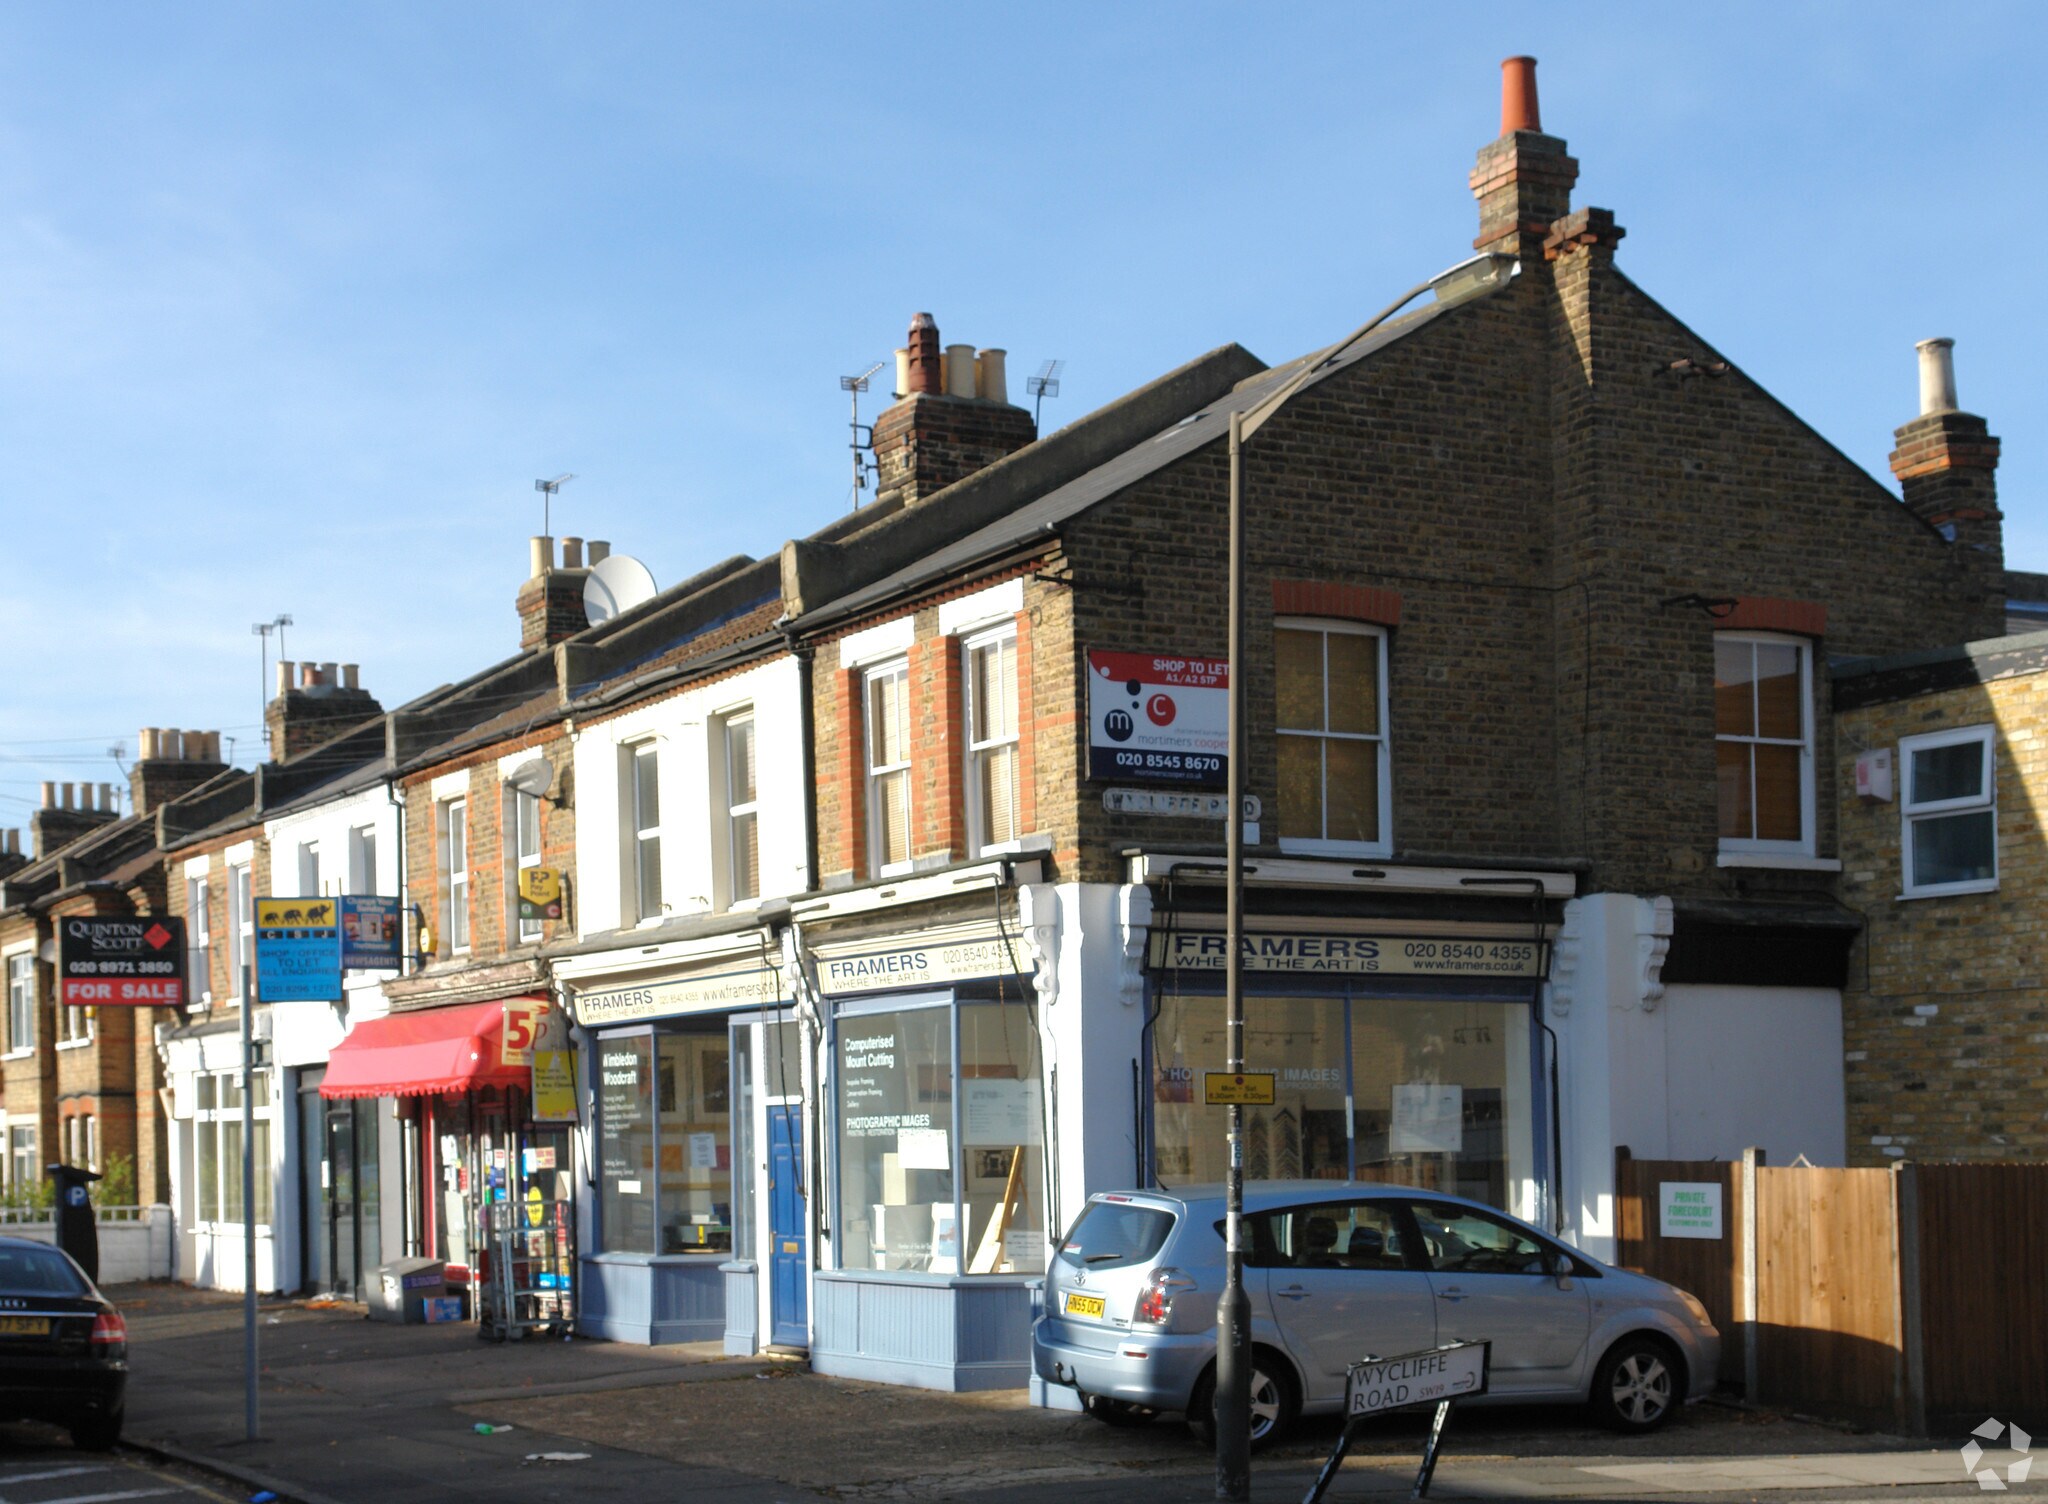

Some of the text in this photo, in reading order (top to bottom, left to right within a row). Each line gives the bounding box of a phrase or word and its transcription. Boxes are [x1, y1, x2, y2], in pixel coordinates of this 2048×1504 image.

[1153, 659, 1229, 676] SHOP TO LET
[1166, 673, 1217, 685] A1/A2 STP
[1137, 734, 1229, 751] mortimers cooper
[1116, 752, 1220, 771] 020 8545 8670
[1111, 793, 1200, 810] WLFFE
[68, 920, 144, 939] QUINTON
[266, 930, 276, 939] C
[320, 930, 328, 939] J
[91, 936, 143, 950] SCOTT
[260, 949, 289, 957] SHOP
[298, 949, 336, 957] OFFICE
[943, 942, 1017, 965] 020 8540 4355
[1404, 943, 1532, 960] 020 8540 4355
[69, 961, 174, 973] 020 8971 3850
[278, 957, 320, 967] TO LET
[344, 956, 398, 966] NEWSAGENTS
[830, 953, 928, 979] FRAMERS
[1175, 955, 1380, 971] WHEE THE ART IS
[1413, 959, 1524, 972] www.framers.co.uk
[261, 967, 337, 976] ALL ENQUIRIES
[833, 971, 930, 989] WHERE THE ART IS
[67, 983, 178, 999] FOR SALE
[265, 985, 282, 993] 020
[286, 984, 309, 993] 8296
[584, 990, 653, 1012] FRAMERS
[587, 1005, 655, 1021] WHERE THE ART IS
[844, 1034, 894, 1053] Computerised
[602, 1052, 638, 1068] Wimbledon
[845, 1052, 894, 1069] Mount Cutting
[602, 1070, 637, 1086] Woodcraft
[1284, 1068, 1341, 1081] IMAGES
[1245, 1084, 1257, 1092] Sat
[846, 1113, 930, 1129] PHOTOGRAPHIC IMAGES
[70, 1186, 85, 1206] P
[1674, 1192, 1706, 1203] PRIVATE
[1667, 1205, 1713, 1217] FORECOURT
[1356, 1354, 1447, 1387] WYCLIFFE
[1353, 1384, 1445, 1411] ROAD SW19
